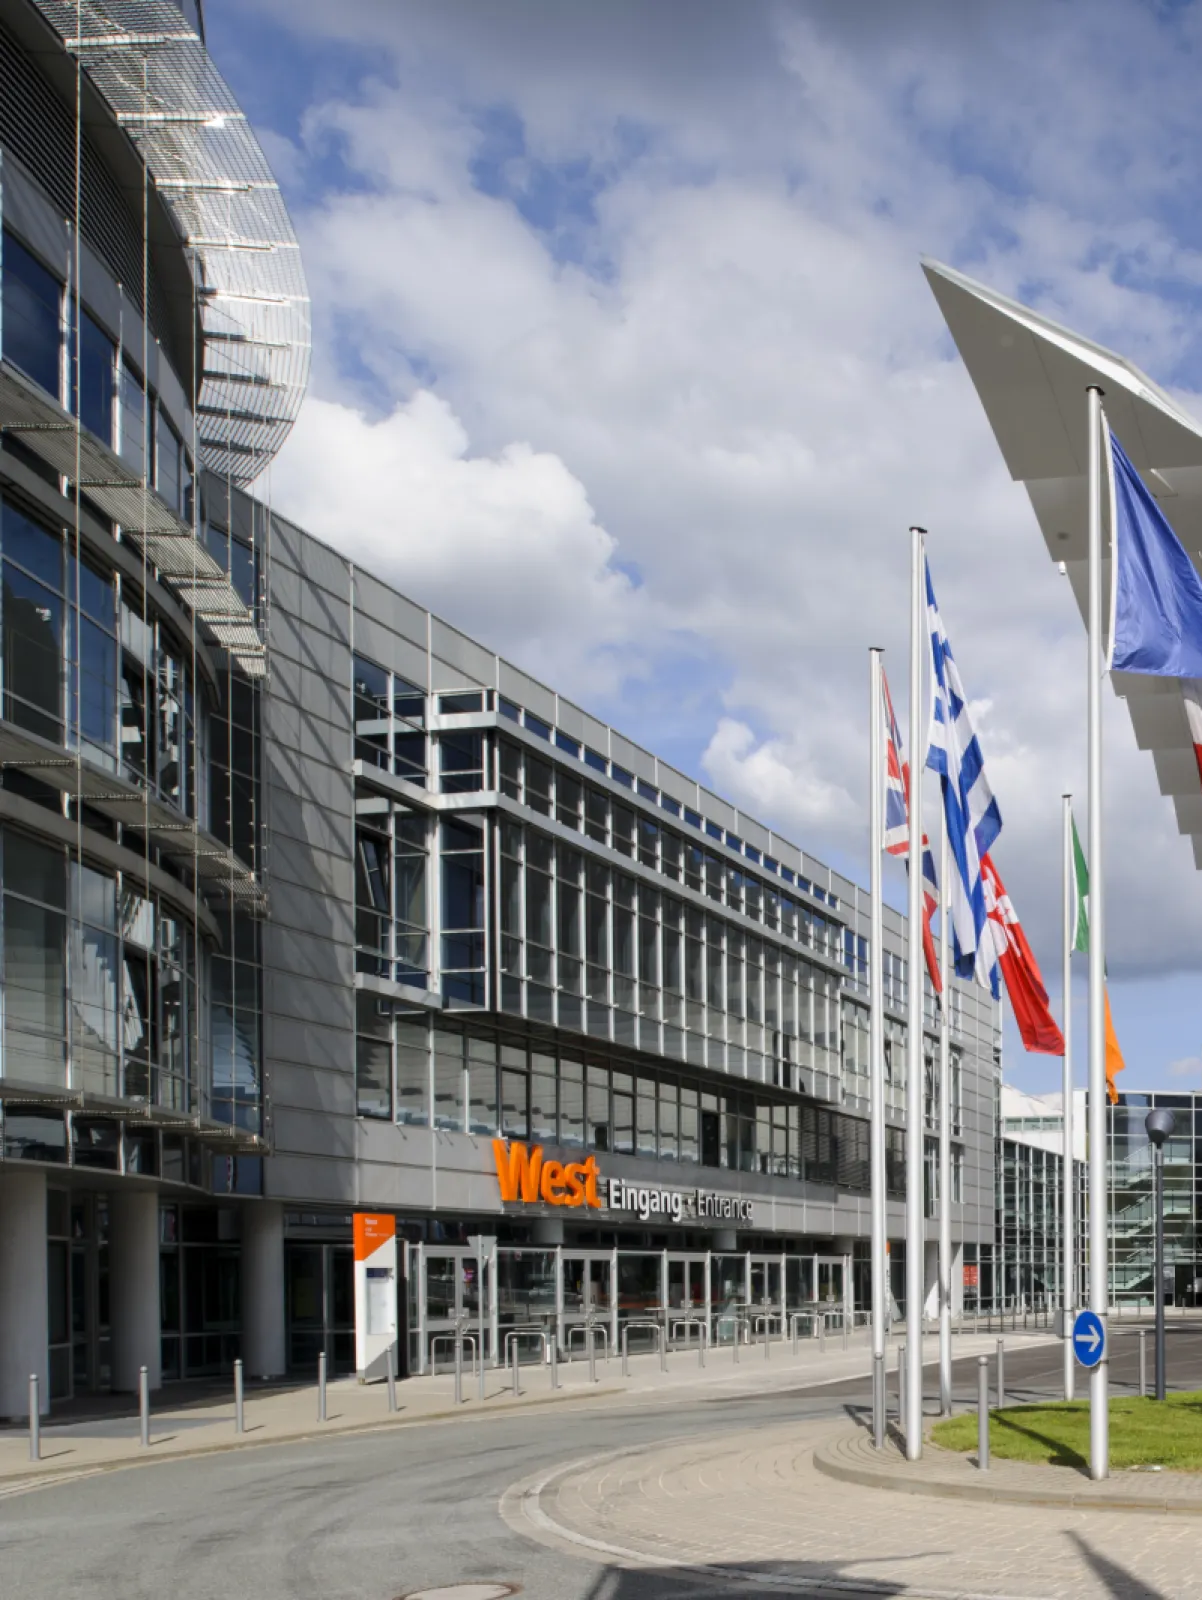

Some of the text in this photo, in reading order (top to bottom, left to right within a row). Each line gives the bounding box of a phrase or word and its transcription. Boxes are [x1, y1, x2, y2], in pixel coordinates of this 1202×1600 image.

[491, 1138, 602, 1209] West
[607, 1177, 754, 1223] Eingang Entrance
